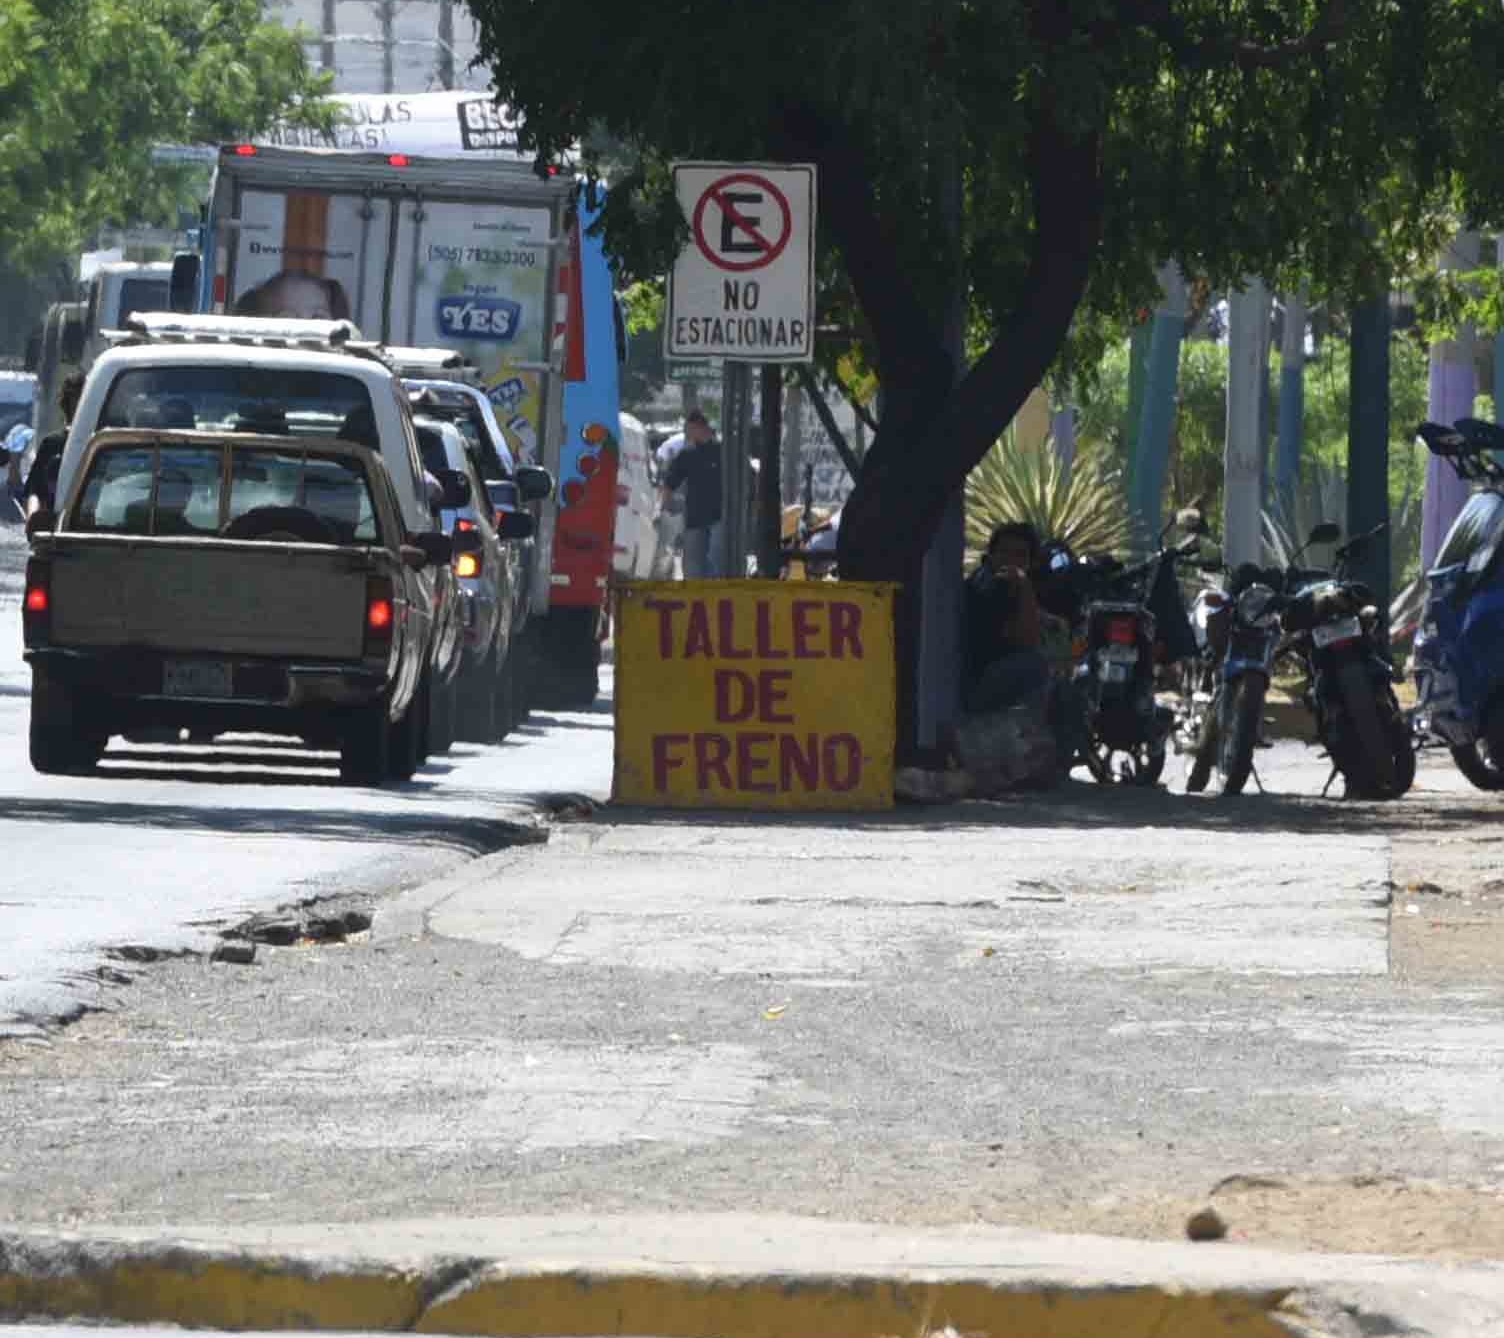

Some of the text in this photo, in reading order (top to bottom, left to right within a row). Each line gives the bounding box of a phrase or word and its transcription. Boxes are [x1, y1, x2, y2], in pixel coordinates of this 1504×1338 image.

[720, 193, 764, 254] E
[442, 301, 511, 334] YES
[723, 280, 760, 312] NO
[675, 316, 805, 348] ESTACIONAR
[644, 597, 864, 661] TALLER
[713, 668, 796, 724] DE
[651, 731, 863, 793] FRENO
